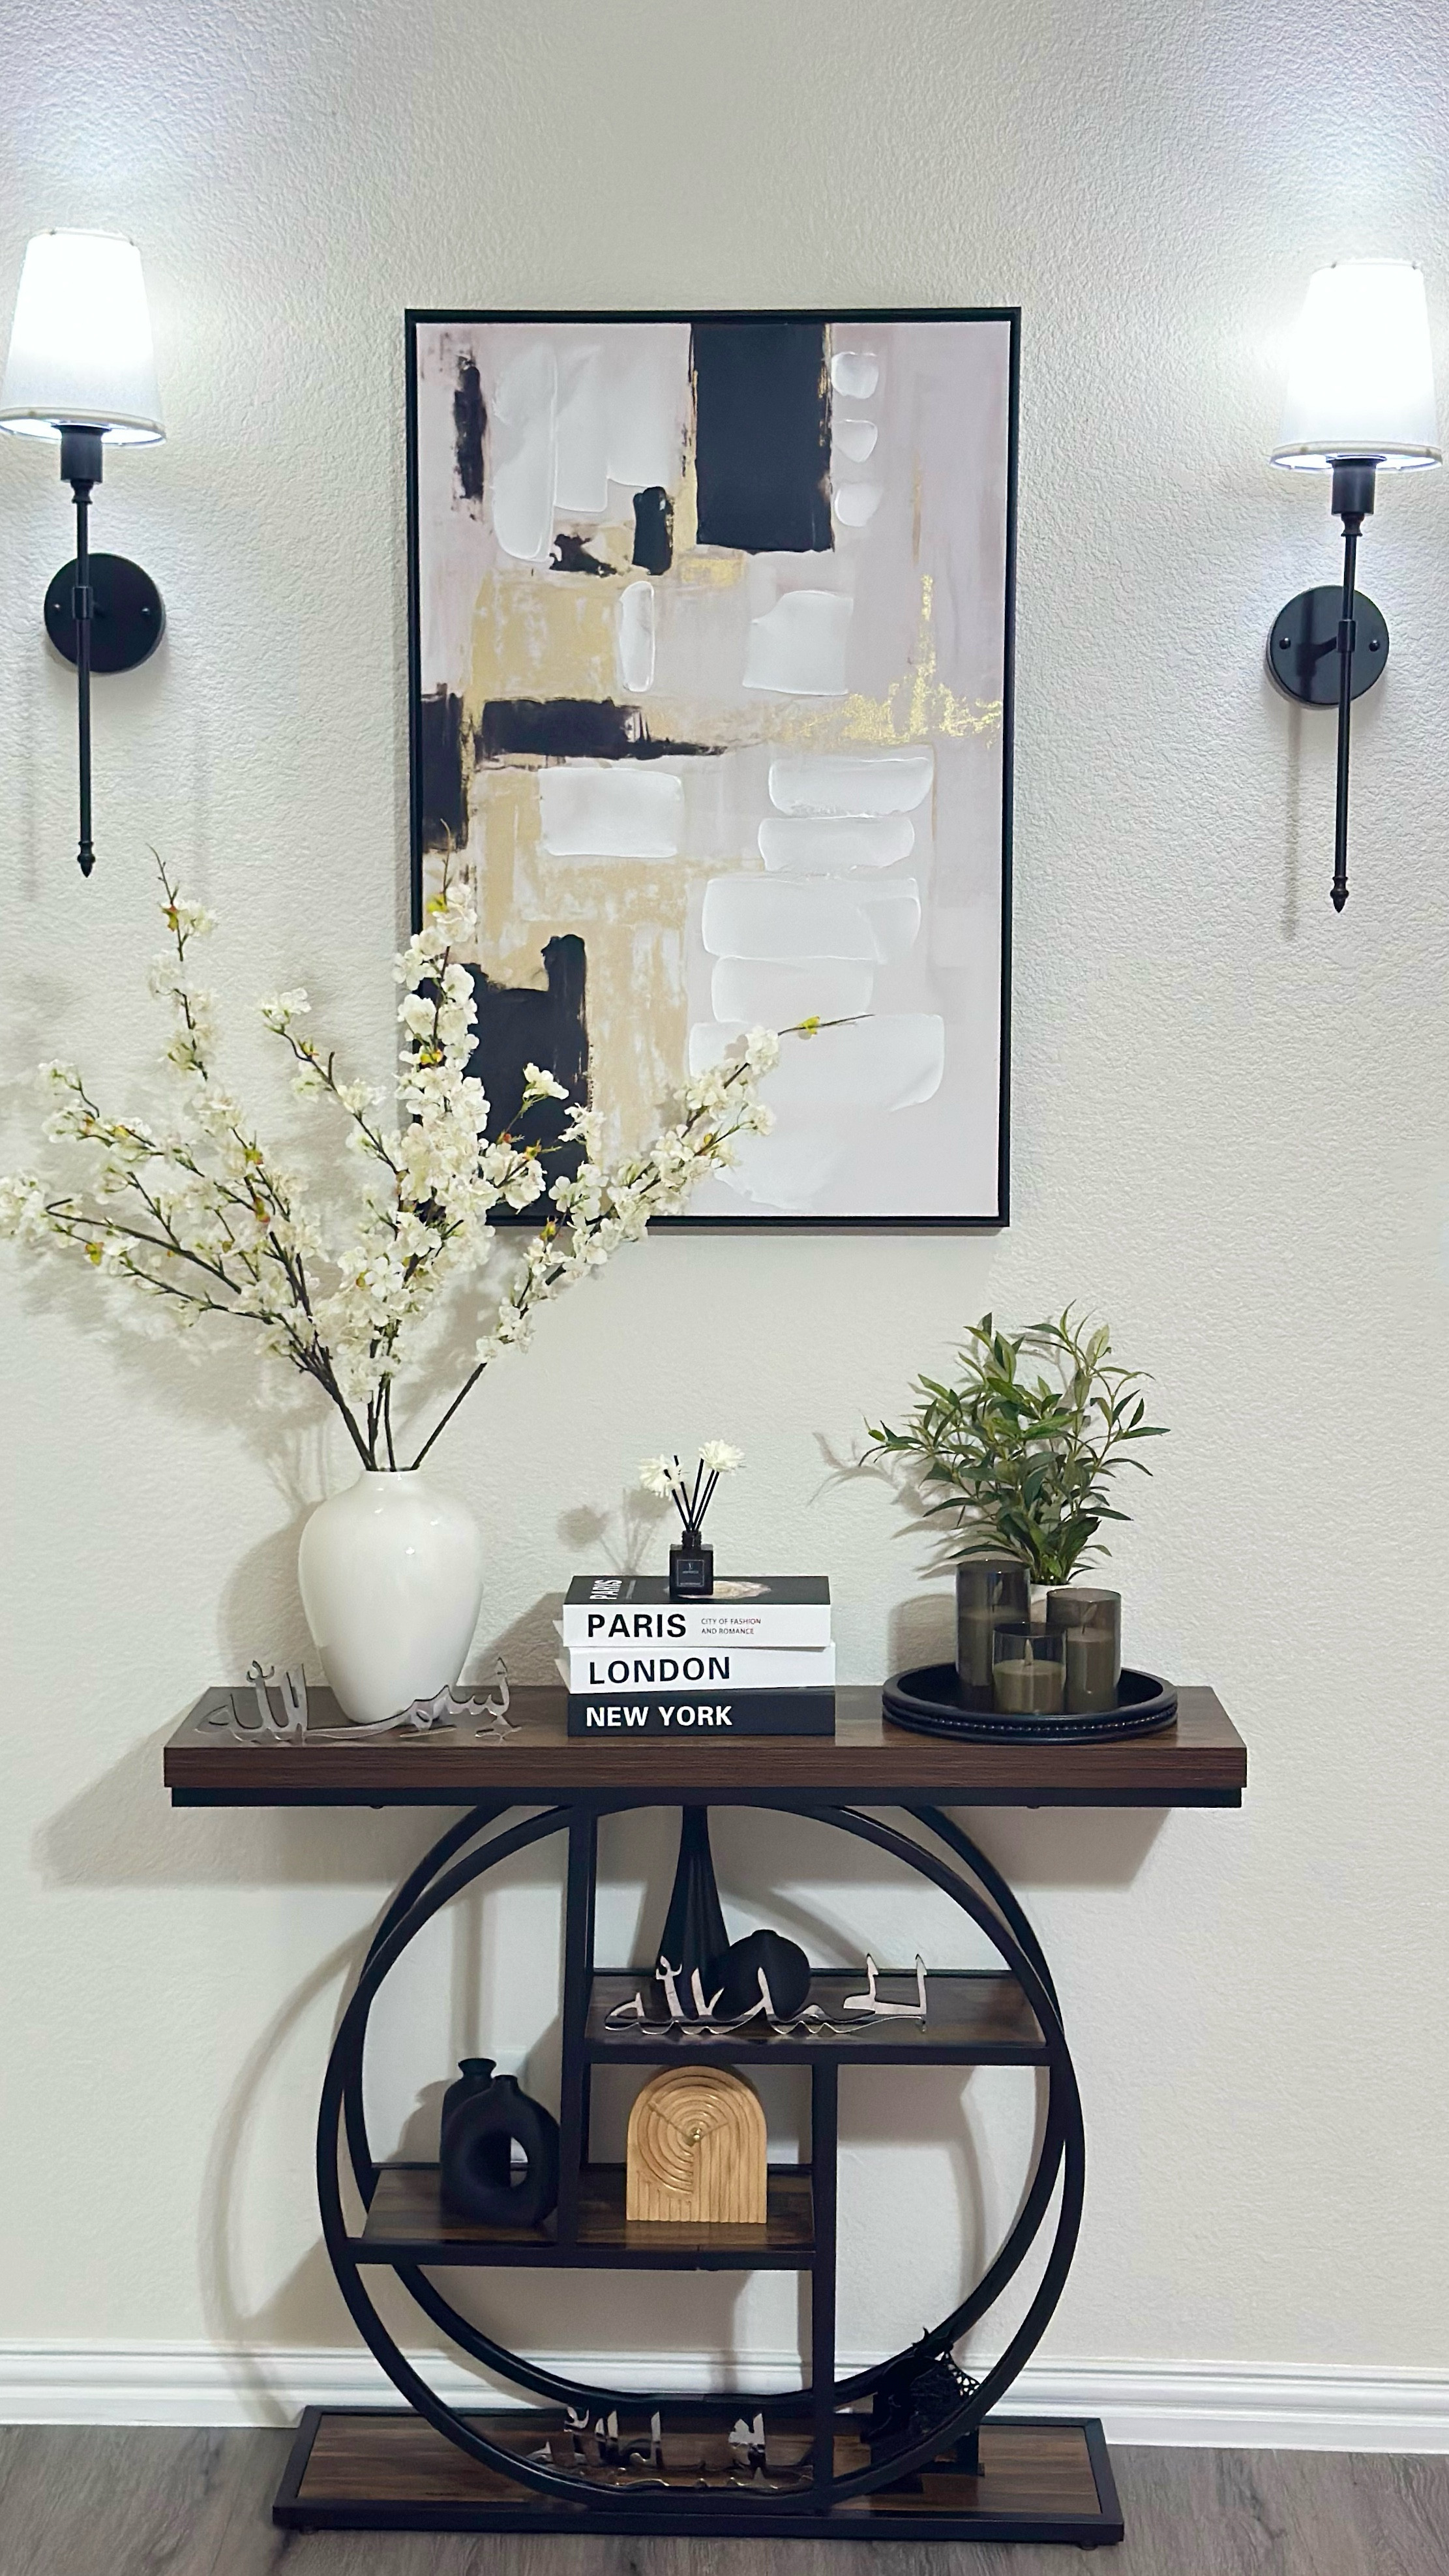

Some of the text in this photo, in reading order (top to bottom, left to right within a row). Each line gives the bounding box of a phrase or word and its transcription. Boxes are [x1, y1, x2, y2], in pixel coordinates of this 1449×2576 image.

[589, 1580, 623, 1600] PARIS
[588, 1613, 686, 1638] PARIS
[590, 1656, 730, 1685] LONDON
[586, 1705, 733, 1727] NEW YORK
